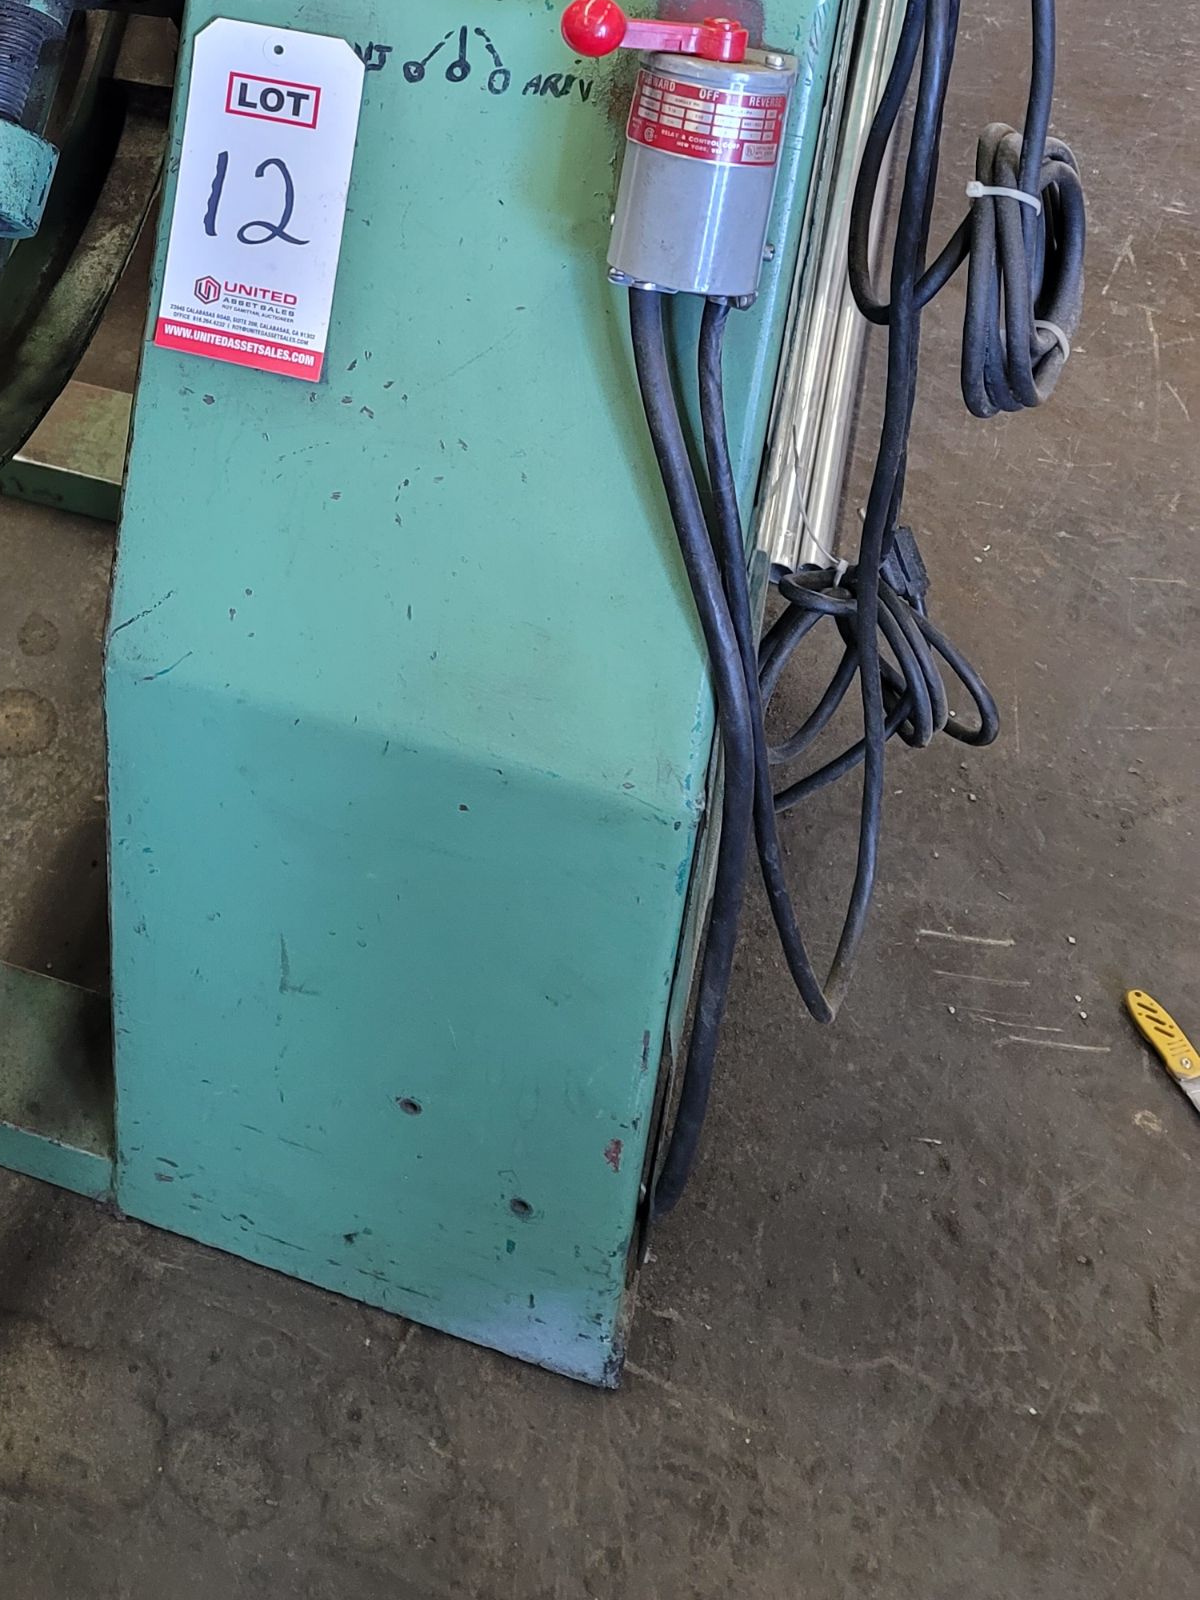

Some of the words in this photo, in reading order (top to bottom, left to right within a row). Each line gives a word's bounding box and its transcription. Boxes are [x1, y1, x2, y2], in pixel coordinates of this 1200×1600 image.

[237, 82, 311, 118] LOT
[698, 88, 720, 102] OFF
[748, 96, 783, 108] REVERSE
[203, 151, 311, 246] 12
[224, 281, 298, 306] UNITED
[173, 311, 190, 320] OFFICE
[186, 307, 216, 319] CALABASAS
[222, 296, 259, 309] ASSET
[259, 303, 295, 317] SALES
[261, 313, 294, 323] AUCTIONEER
[164, 323, 315, 366] WWW.UNITEDASSETSALES.COM
